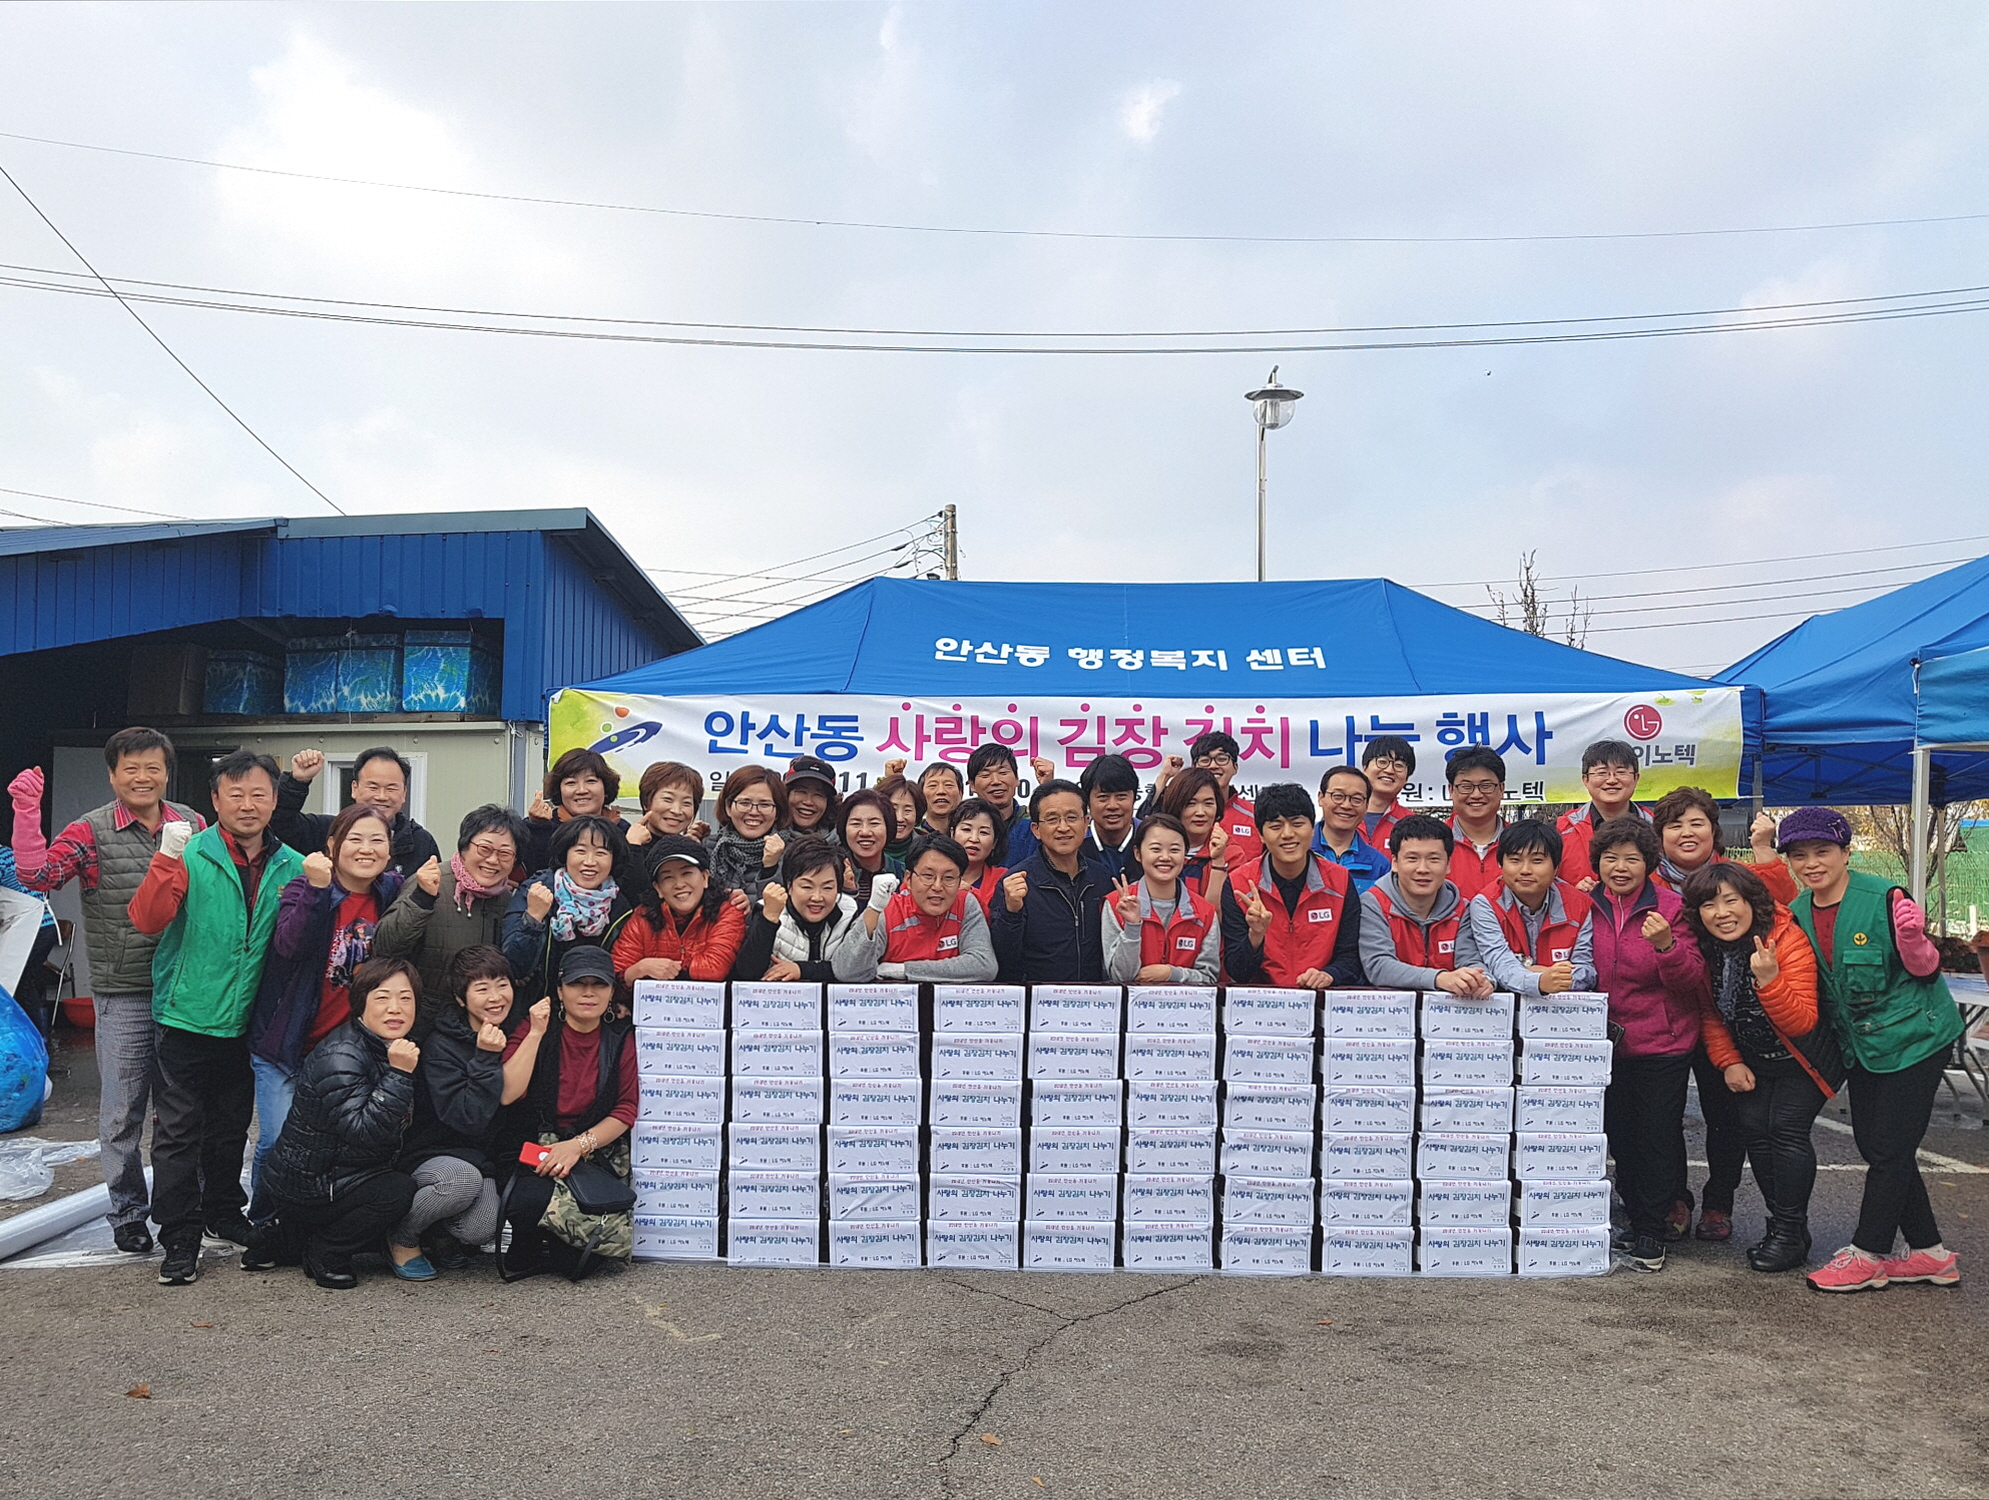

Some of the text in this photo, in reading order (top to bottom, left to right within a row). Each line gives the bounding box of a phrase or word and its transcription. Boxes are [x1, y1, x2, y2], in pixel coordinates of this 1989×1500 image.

[934, 636, 1327, 671] 안산동 행정복지 센터
[704, 711, 864, 762] 안산동
[876, 702, 1039, 764] 사랑의
[1435, 711, 1553, 766] 행사
[1241, 827, 1250, 835] LG
[1319, 910, 1330, 920] LG
[945, 938, 957, 948] LG
[1183, 939, 1194, 948] LG
